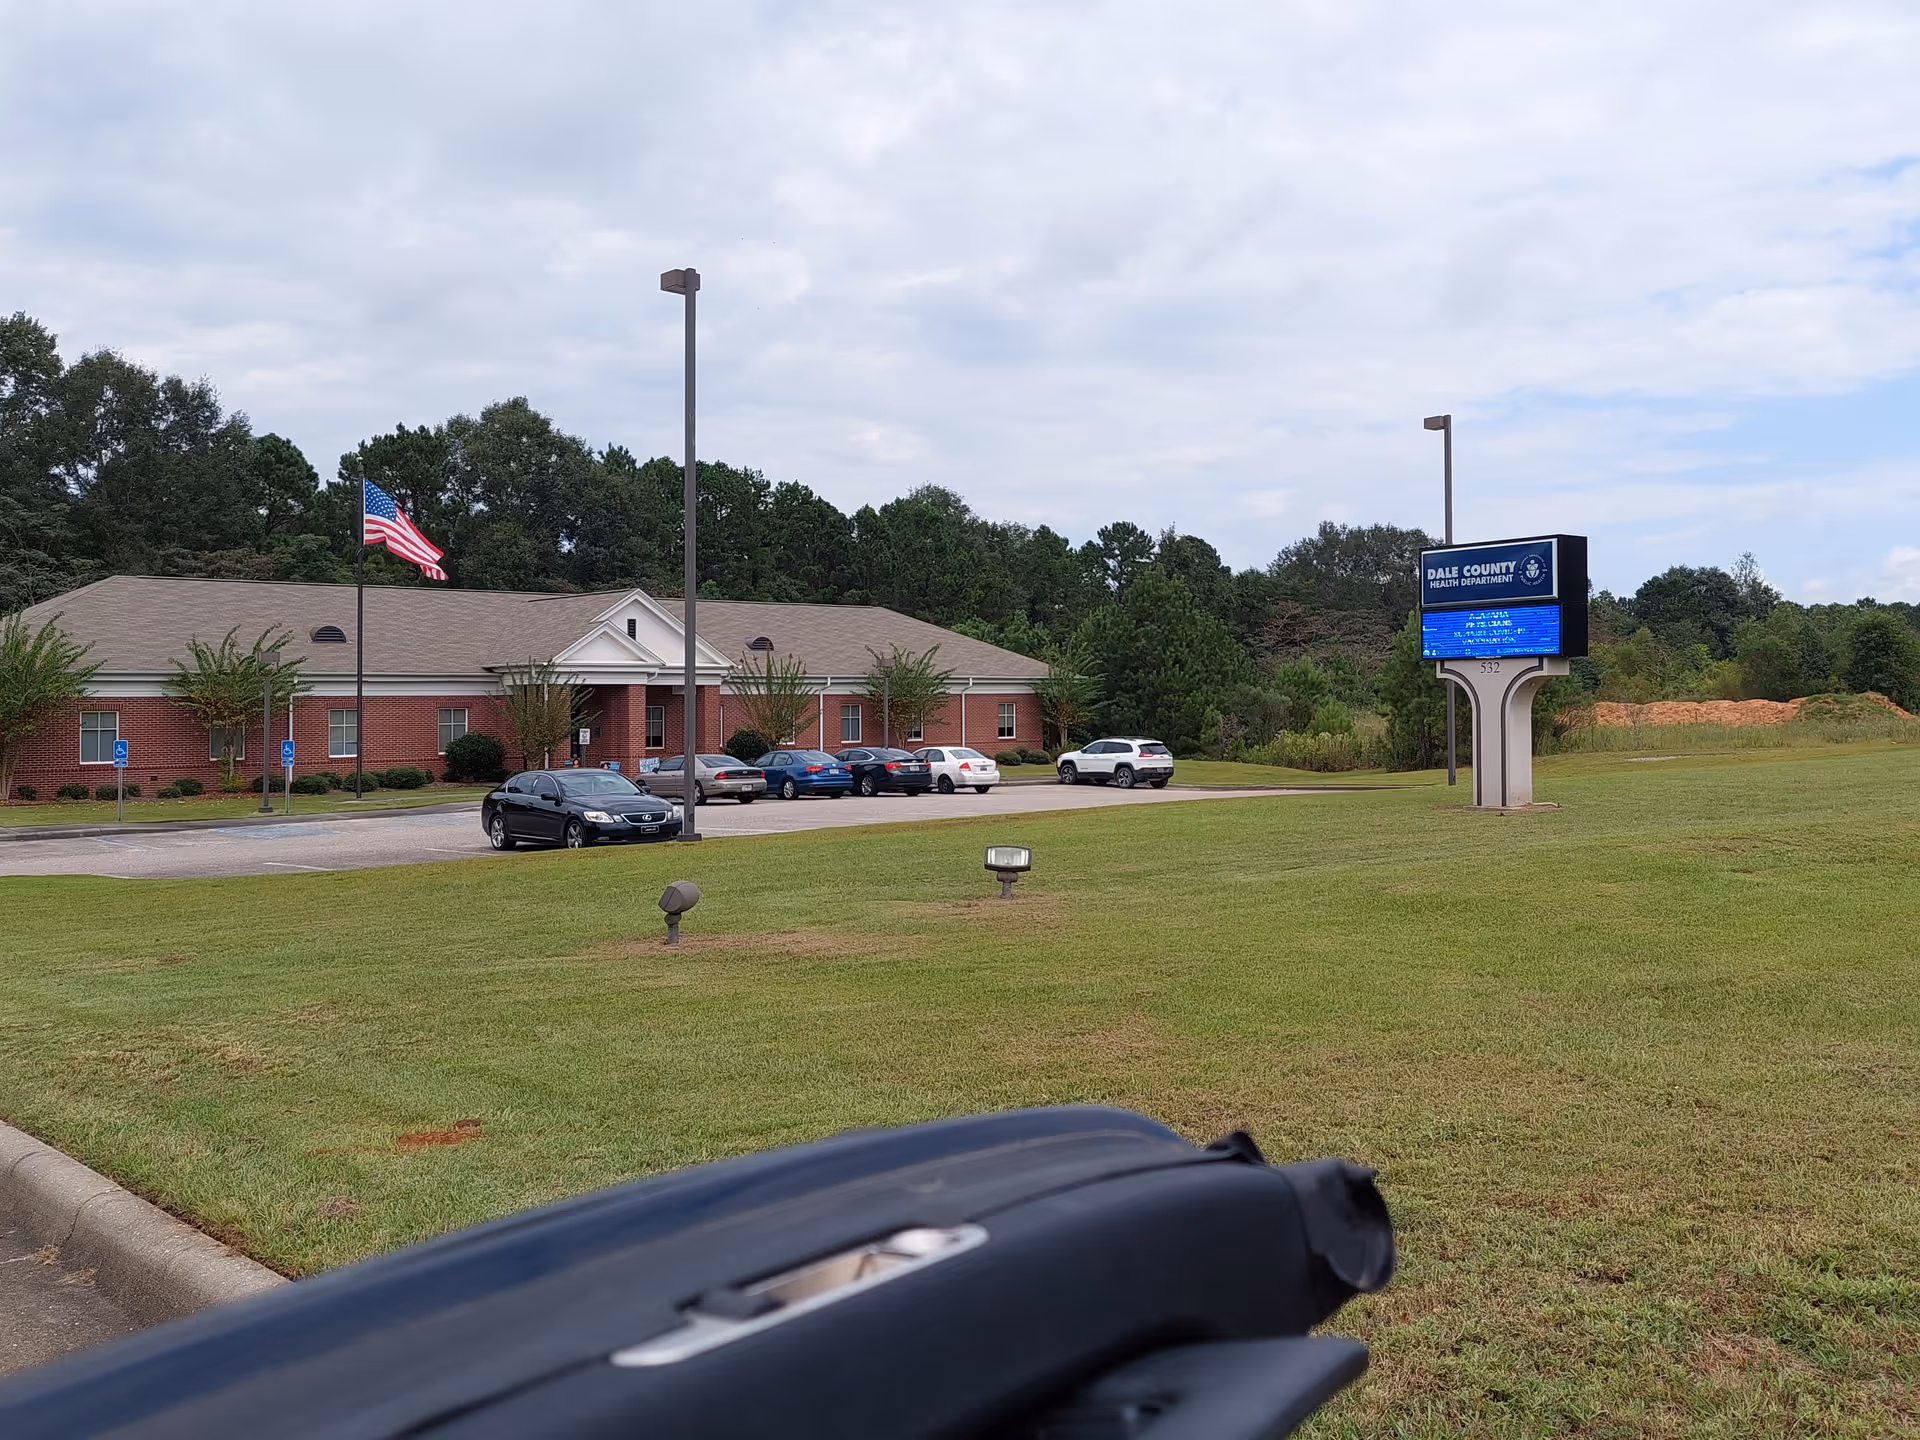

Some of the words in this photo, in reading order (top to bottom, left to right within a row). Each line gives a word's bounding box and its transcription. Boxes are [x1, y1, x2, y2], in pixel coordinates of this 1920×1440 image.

[1427, 566, 1459, 580] DALE
[1463, 560, 1517, 577] COUNTY
[1429, 579, 1459, 589] HEALTH
[1461, 574, 1514, 586] DEPARTMENT
[1532, 573, 1546, 586] HEALTH
[1480, 661, 1500, 673] 532
